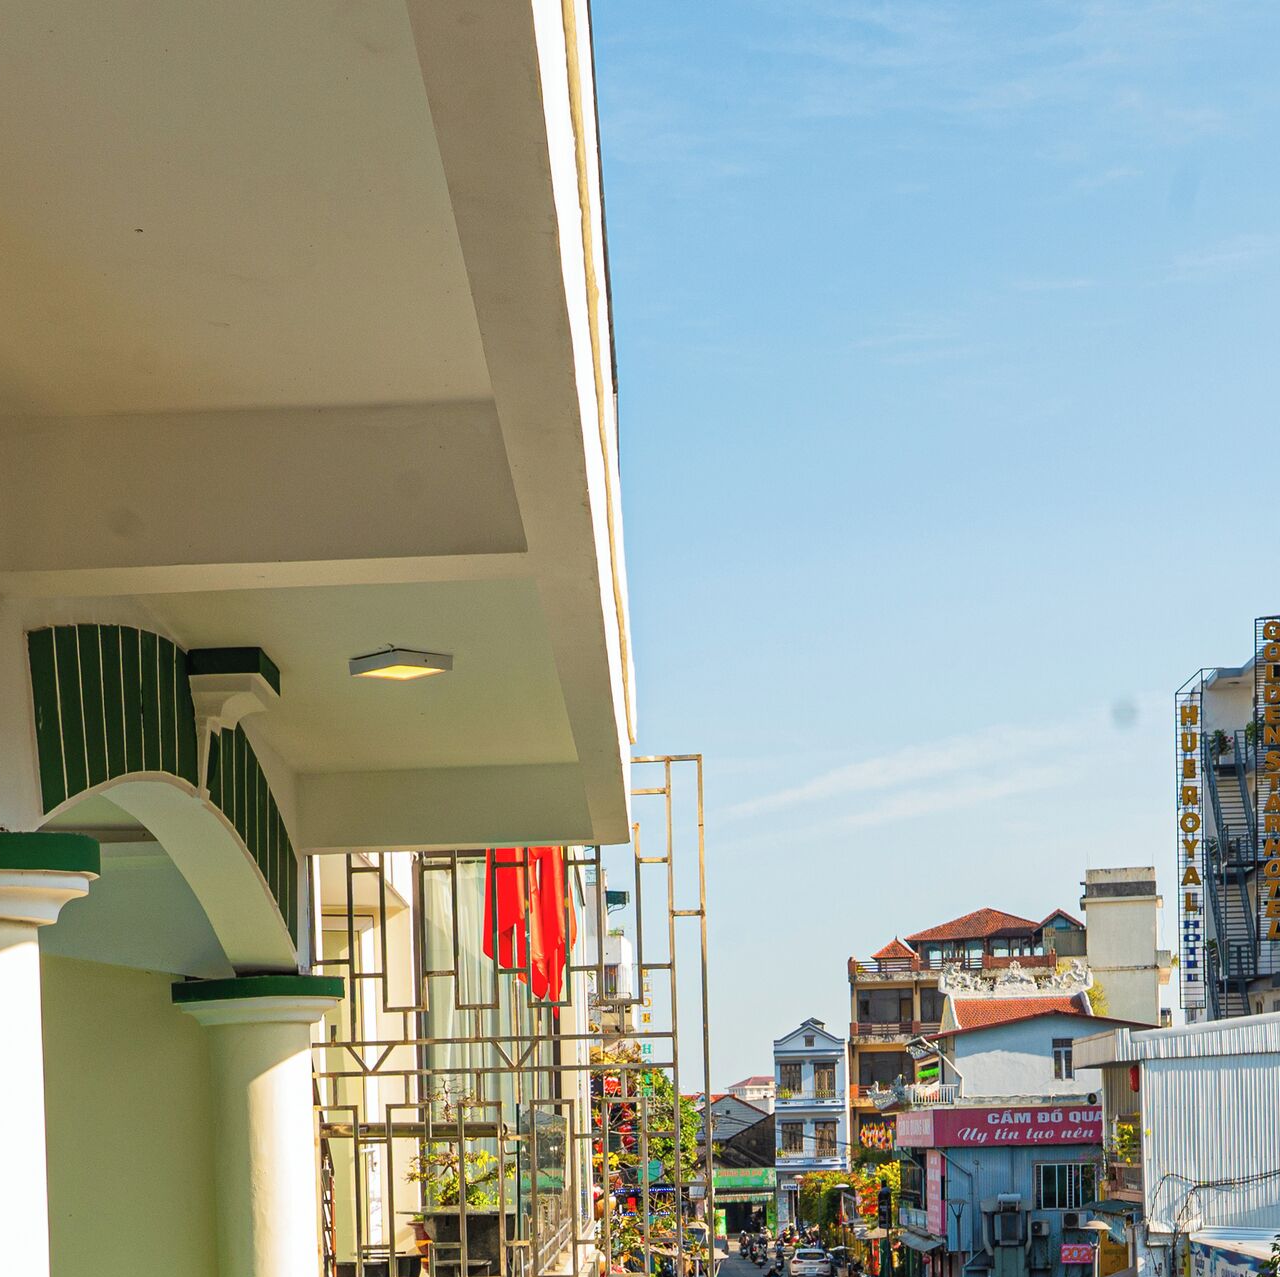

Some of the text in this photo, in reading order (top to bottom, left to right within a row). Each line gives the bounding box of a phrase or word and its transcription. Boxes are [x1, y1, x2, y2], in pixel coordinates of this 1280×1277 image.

[1179, 704, 1201, 912] HUE ROYAL
[1068, 1111, 1102, 1124] QUA
[994, 1127, 1020, 1140] tín
[1026, 1127, 1054, 1143] tạo
[1061, 1127, 1095, 1140] nên
